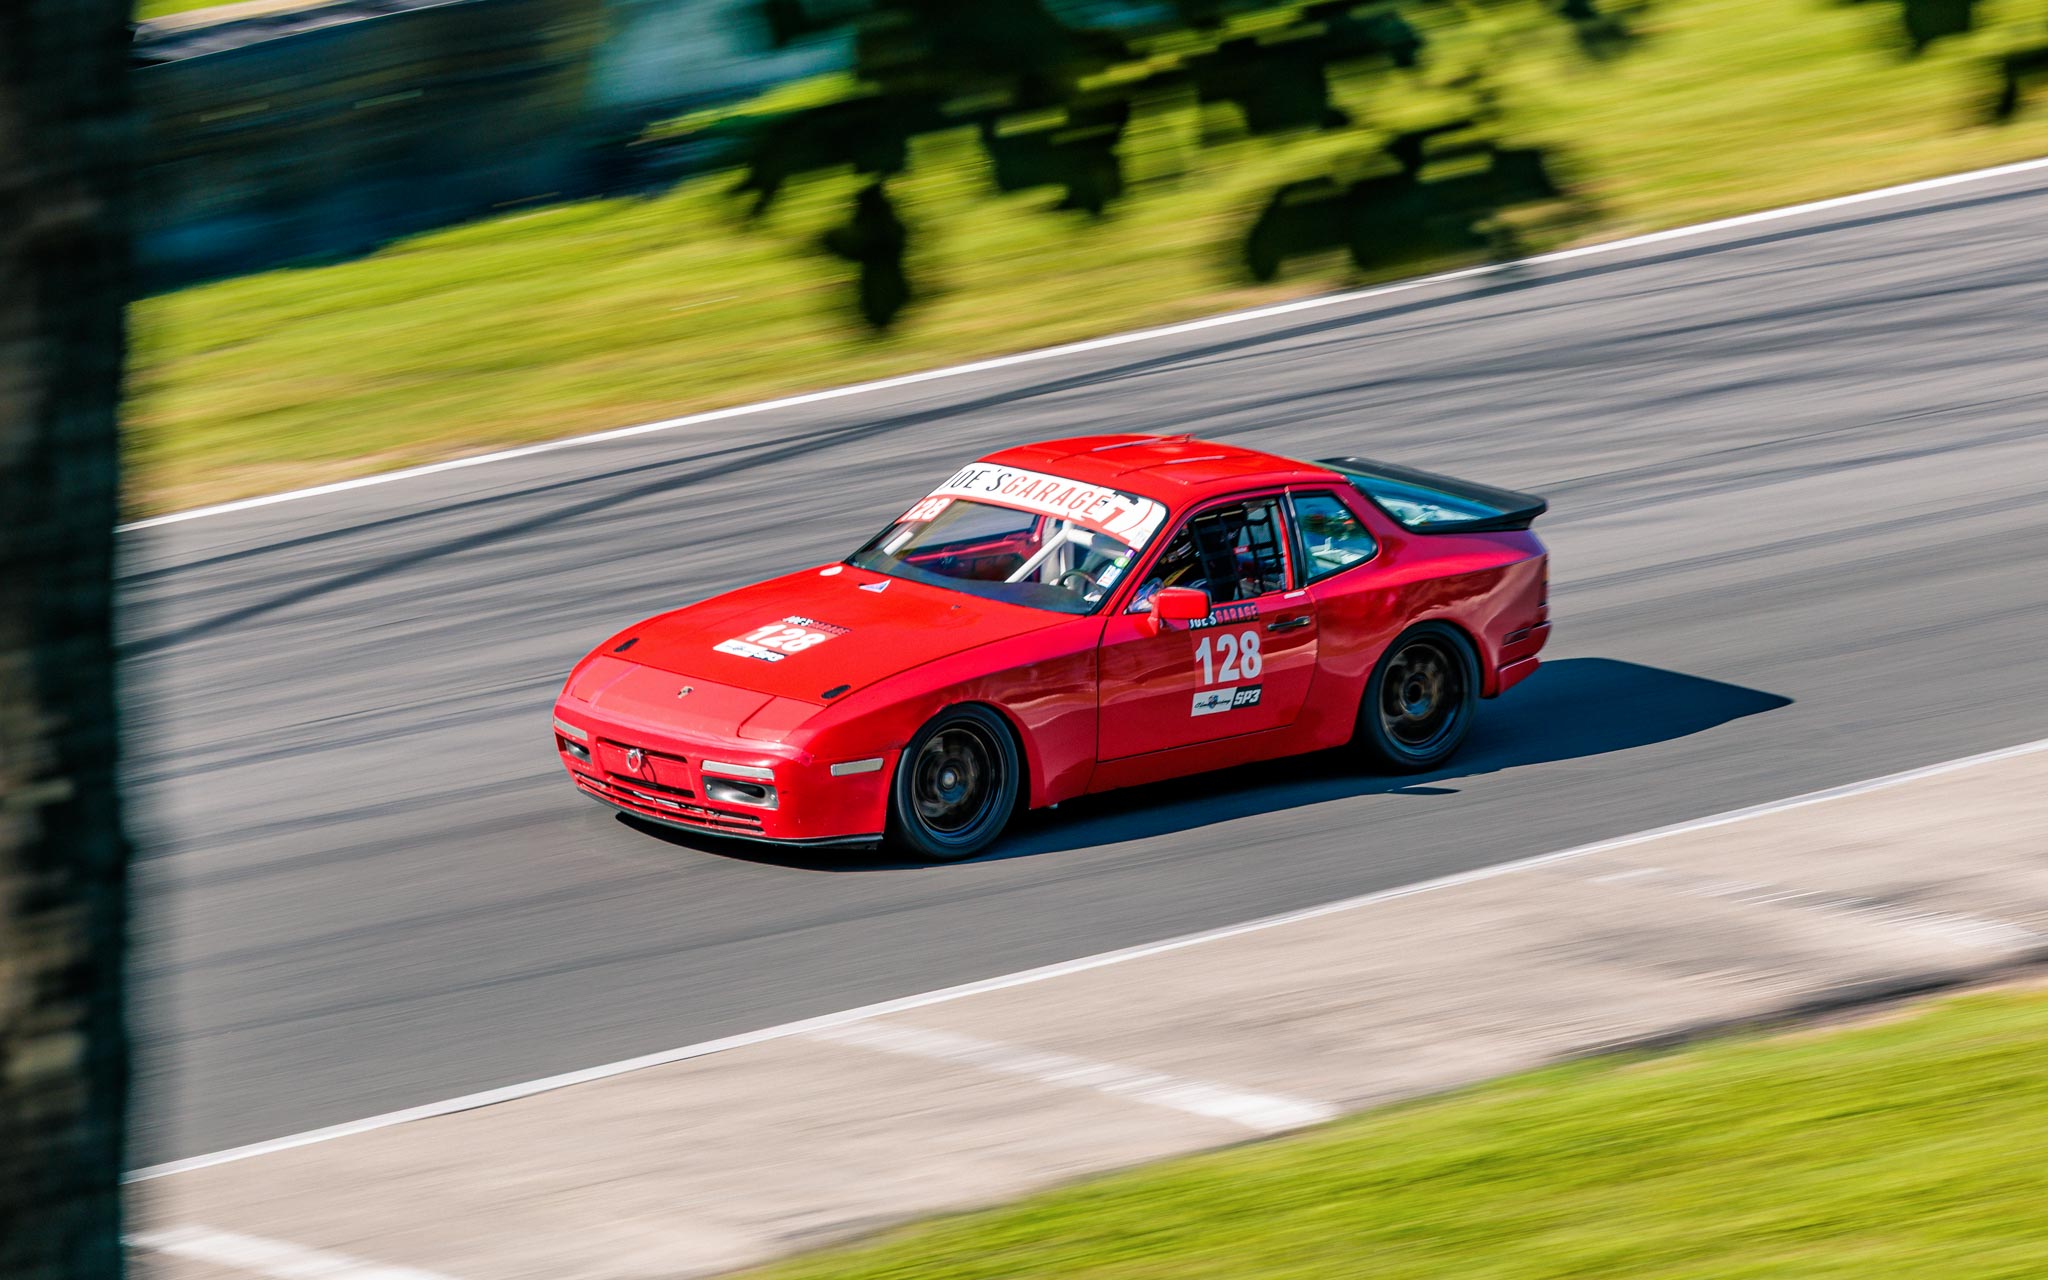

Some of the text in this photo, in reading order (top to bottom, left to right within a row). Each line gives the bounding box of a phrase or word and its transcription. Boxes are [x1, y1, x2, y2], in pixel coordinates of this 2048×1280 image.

[745, 624, 826, 652] 128
[1195, 630, 1263, 686] 128
[1233, 689, 1262, 706] SP3
